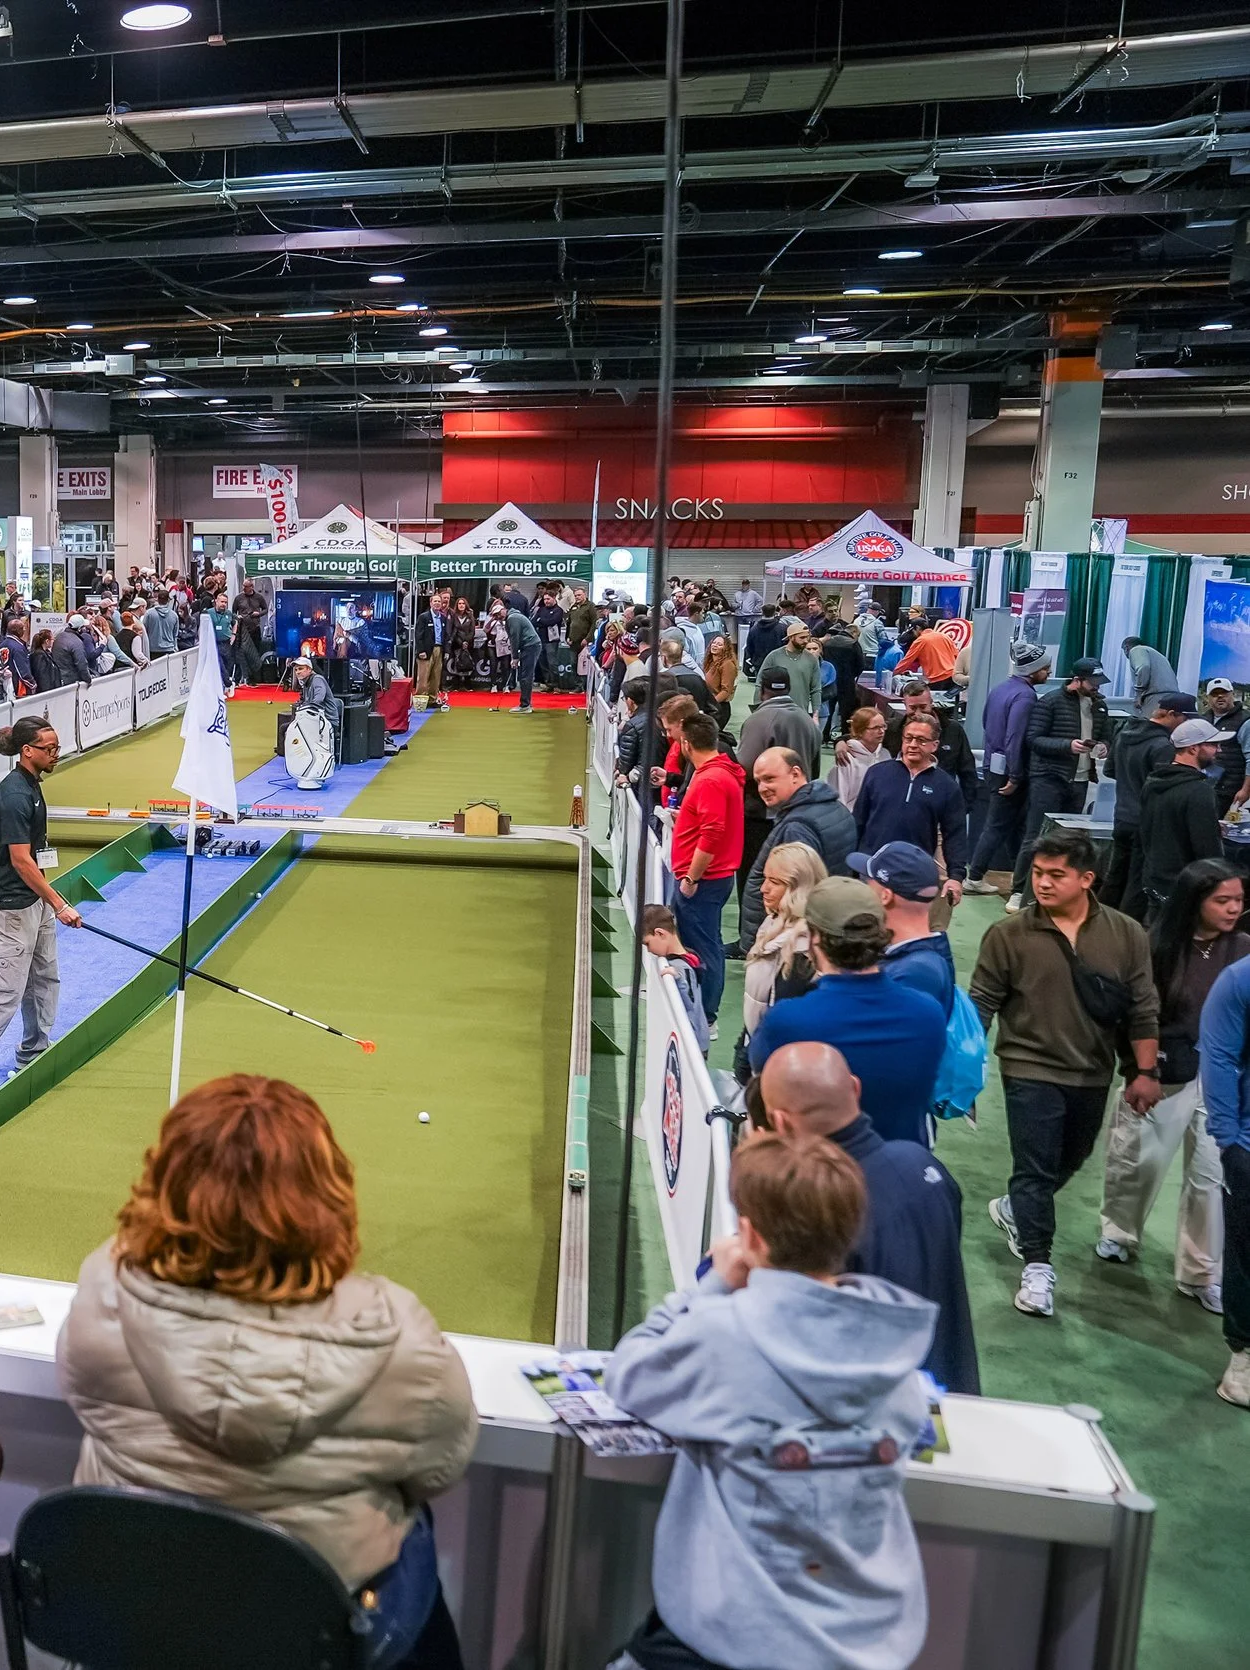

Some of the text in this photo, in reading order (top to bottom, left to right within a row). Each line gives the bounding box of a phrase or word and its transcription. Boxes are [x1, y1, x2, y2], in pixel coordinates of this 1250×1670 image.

[68, 471, 107, 487] EXITS
[216, 469, 248, 485] FIRE
[315, 539, 367, 547] CDGA
[487, 538, 542, 546] CDGA
[257, 559, 399, 574] Better Through Golf
[430, 559, 579, 575] Better Through Golf
[794, 568, 818, 578] U.S.
[821, 569, 879, 581] Adaptive
[882, 570, 912, 580] Golf
[914, 571, 967, 582] Alliance
